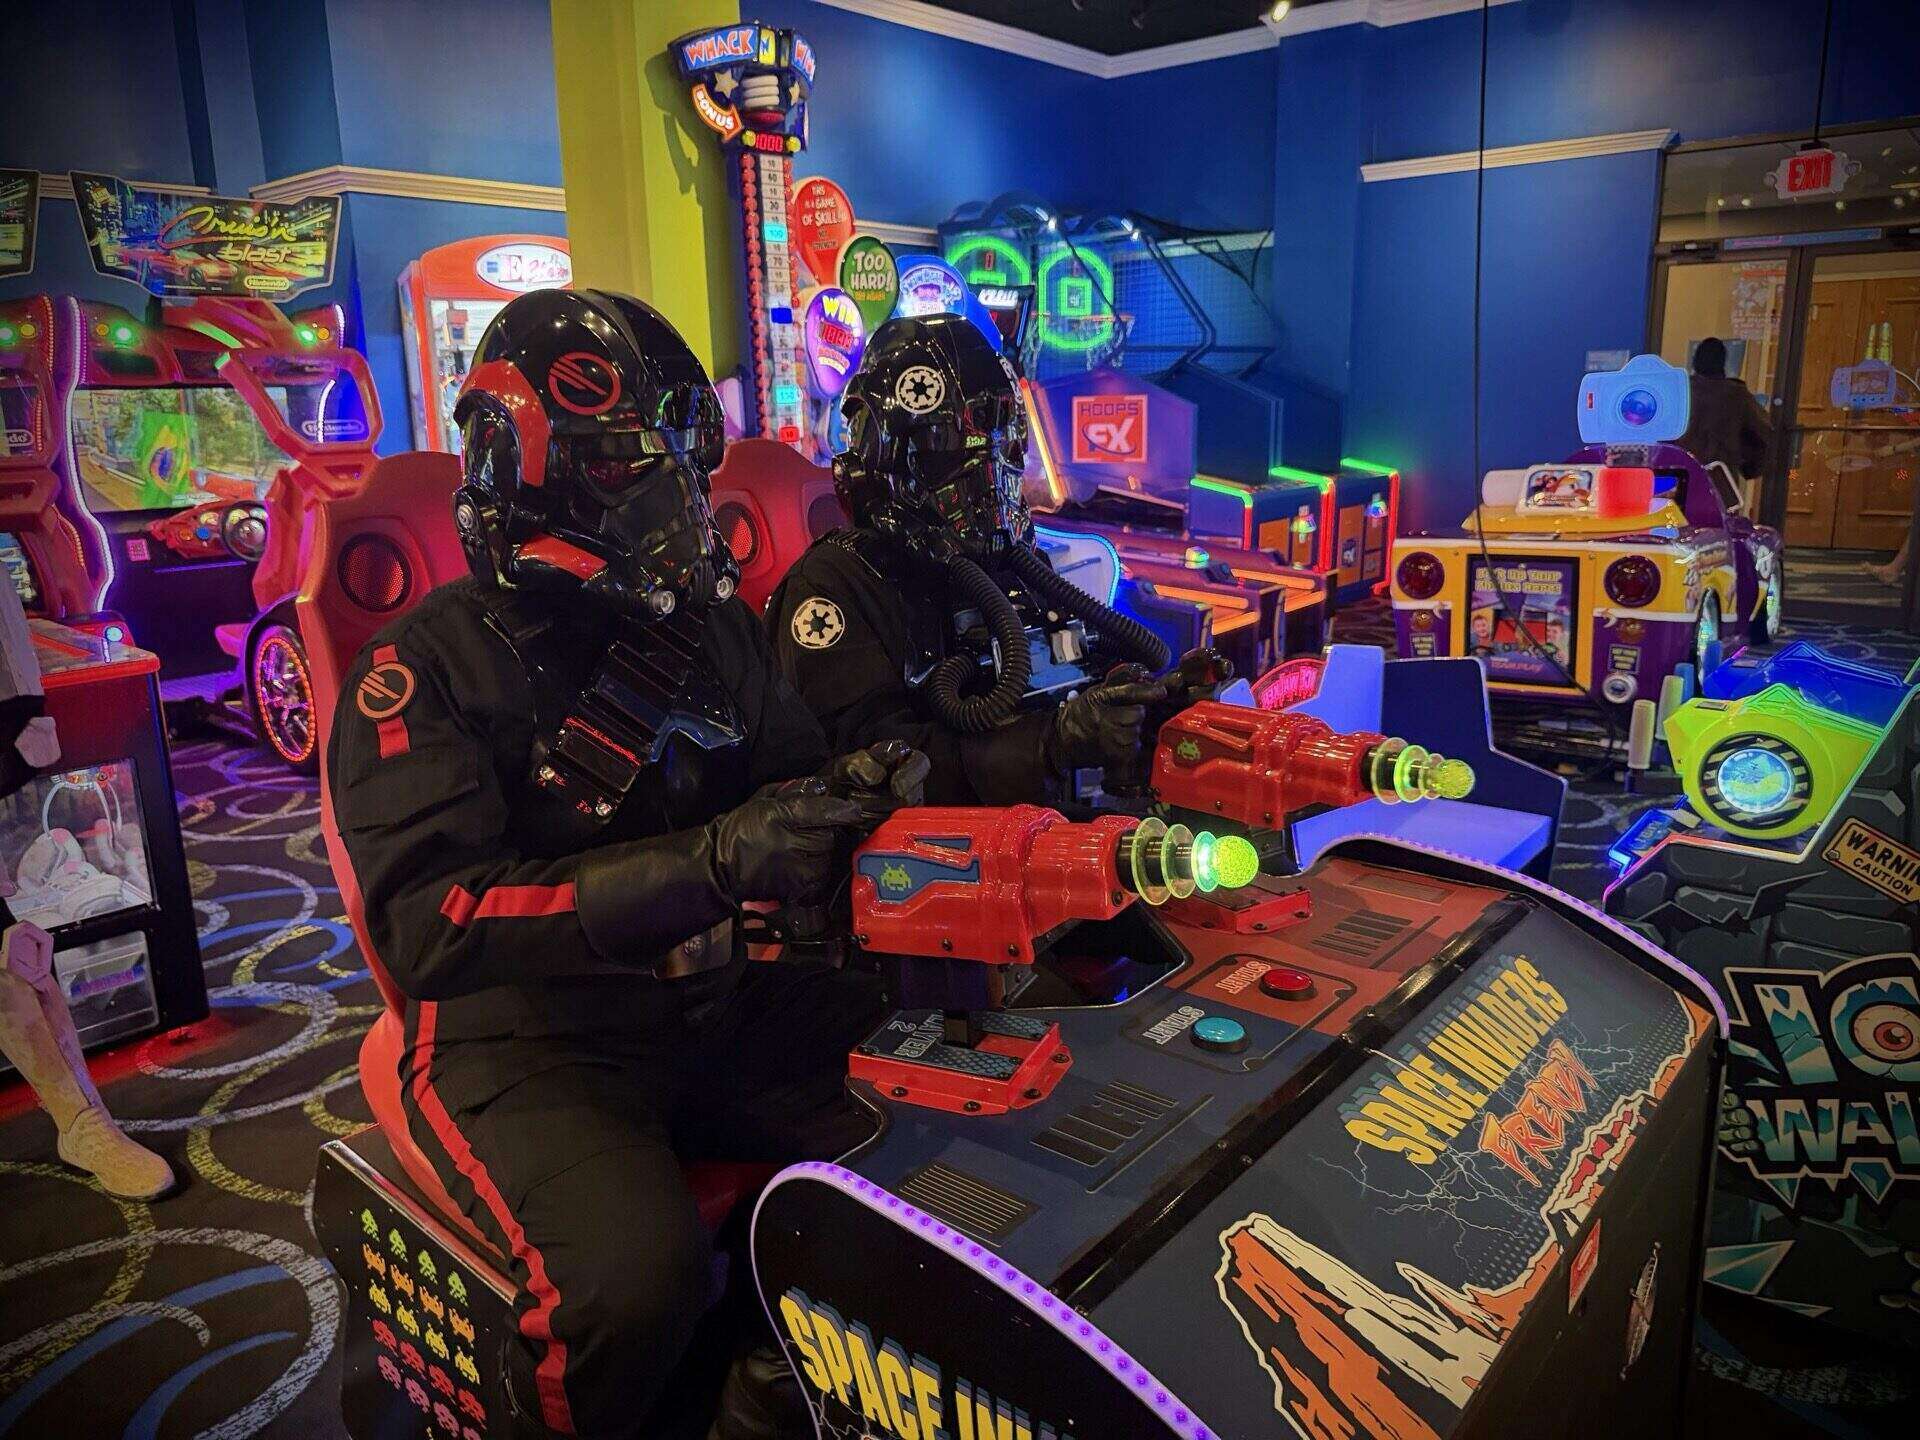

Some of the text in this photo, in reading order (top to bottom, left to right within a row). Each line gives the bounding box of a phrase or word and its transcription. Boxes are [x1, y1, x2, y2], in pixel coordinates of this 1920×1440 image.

[683, 29, 754, 66] WHACK
[696, 90, 734, 130] BONUS
[756, 134, 784, 151] 1000
[1788, 152, 1836, 192] EXIT
[802, 214, 814, 226] OF
[216, 243, 294, 264] blast
[853, 251, 885, 272] TOO
[1081, 402, 1139, 417] HOOPS
[1853, 858, 1914, 896] CAUTION
[1214, 961, 1272, 995] START
[1142, 1005, 1206, 1045] START
[1345, 954, 1568, 1166] SPACE INVADERS
[1478, 1038, 1600, 1189] FRENZY
[780, 1294, 943, 1440] SPACE
